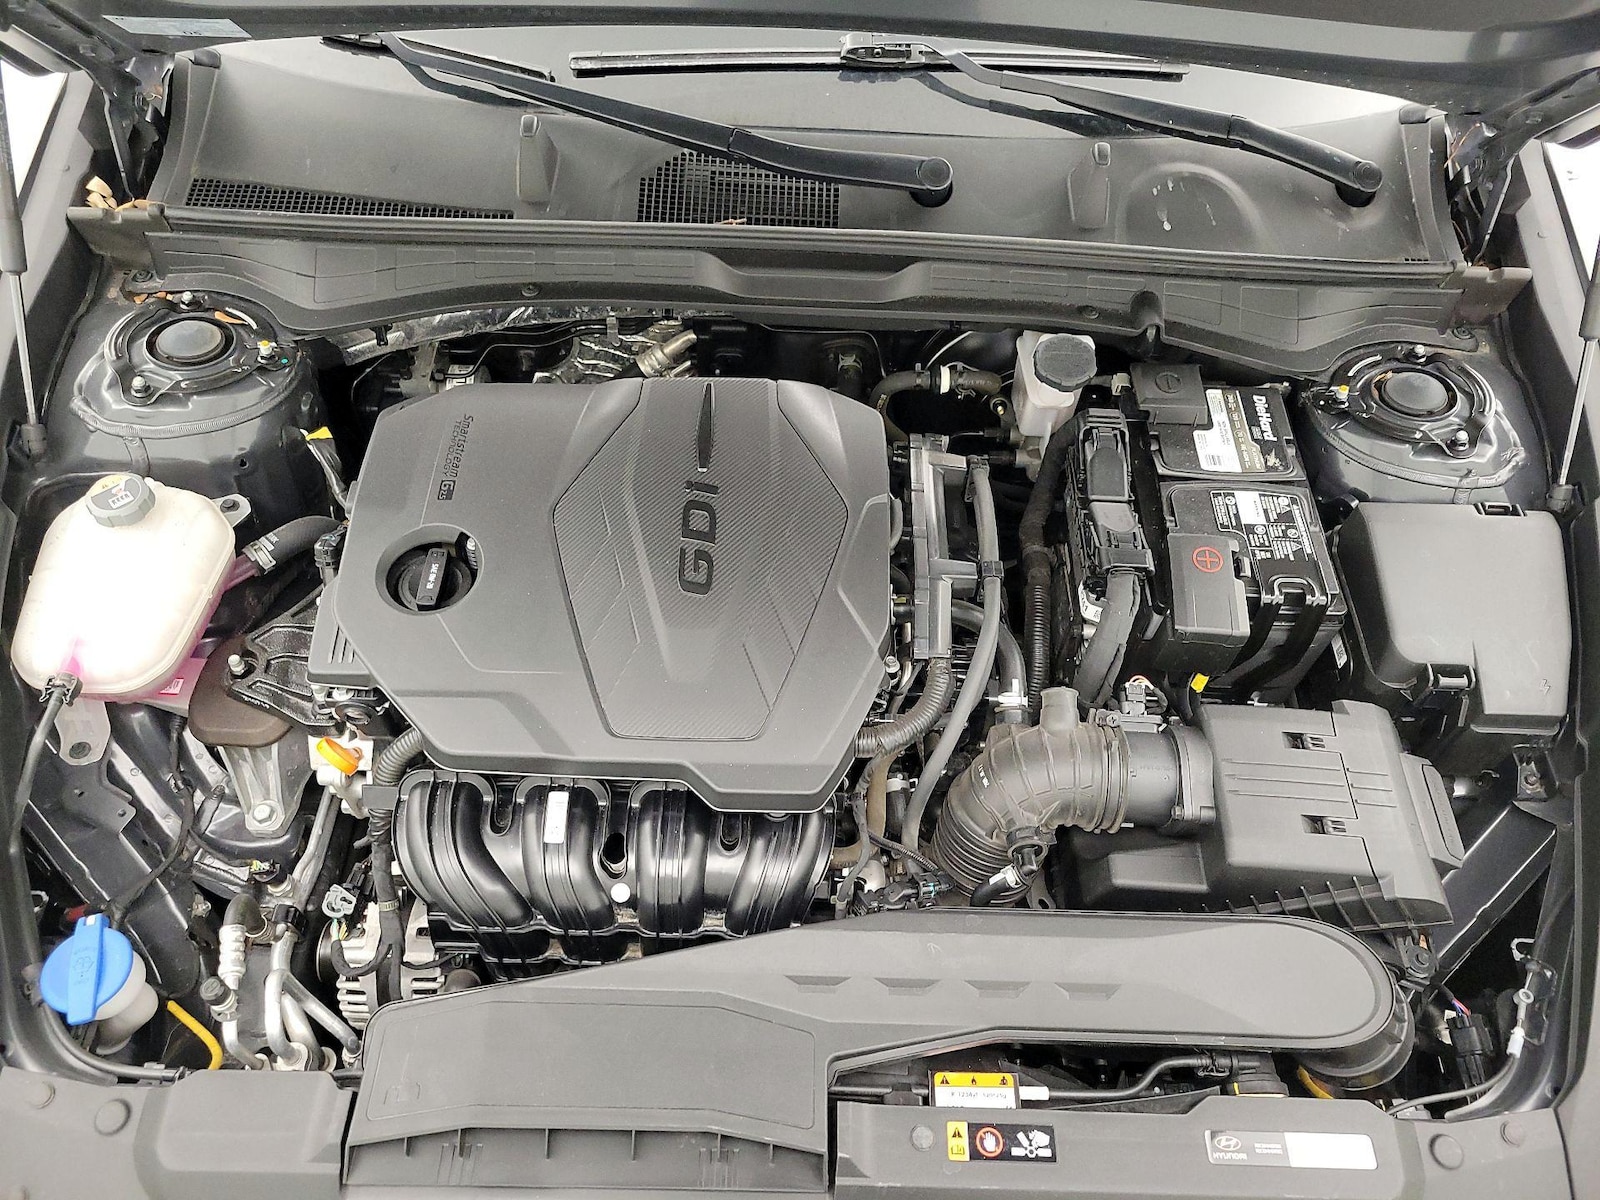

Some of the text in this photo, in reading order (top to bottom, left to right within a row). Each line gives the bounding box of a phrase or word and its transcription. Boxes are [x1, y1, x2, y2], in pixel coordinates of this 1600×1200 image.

[449, 413, 474, 478] Smartstream
[1253, 394, 1278, 441] DieHard
[443, 420, 461, 477] TECHNOLOGY
[678, 480, 719, 596] GDi
[1212, 1152, 1248, 1161] HYUNDAI
